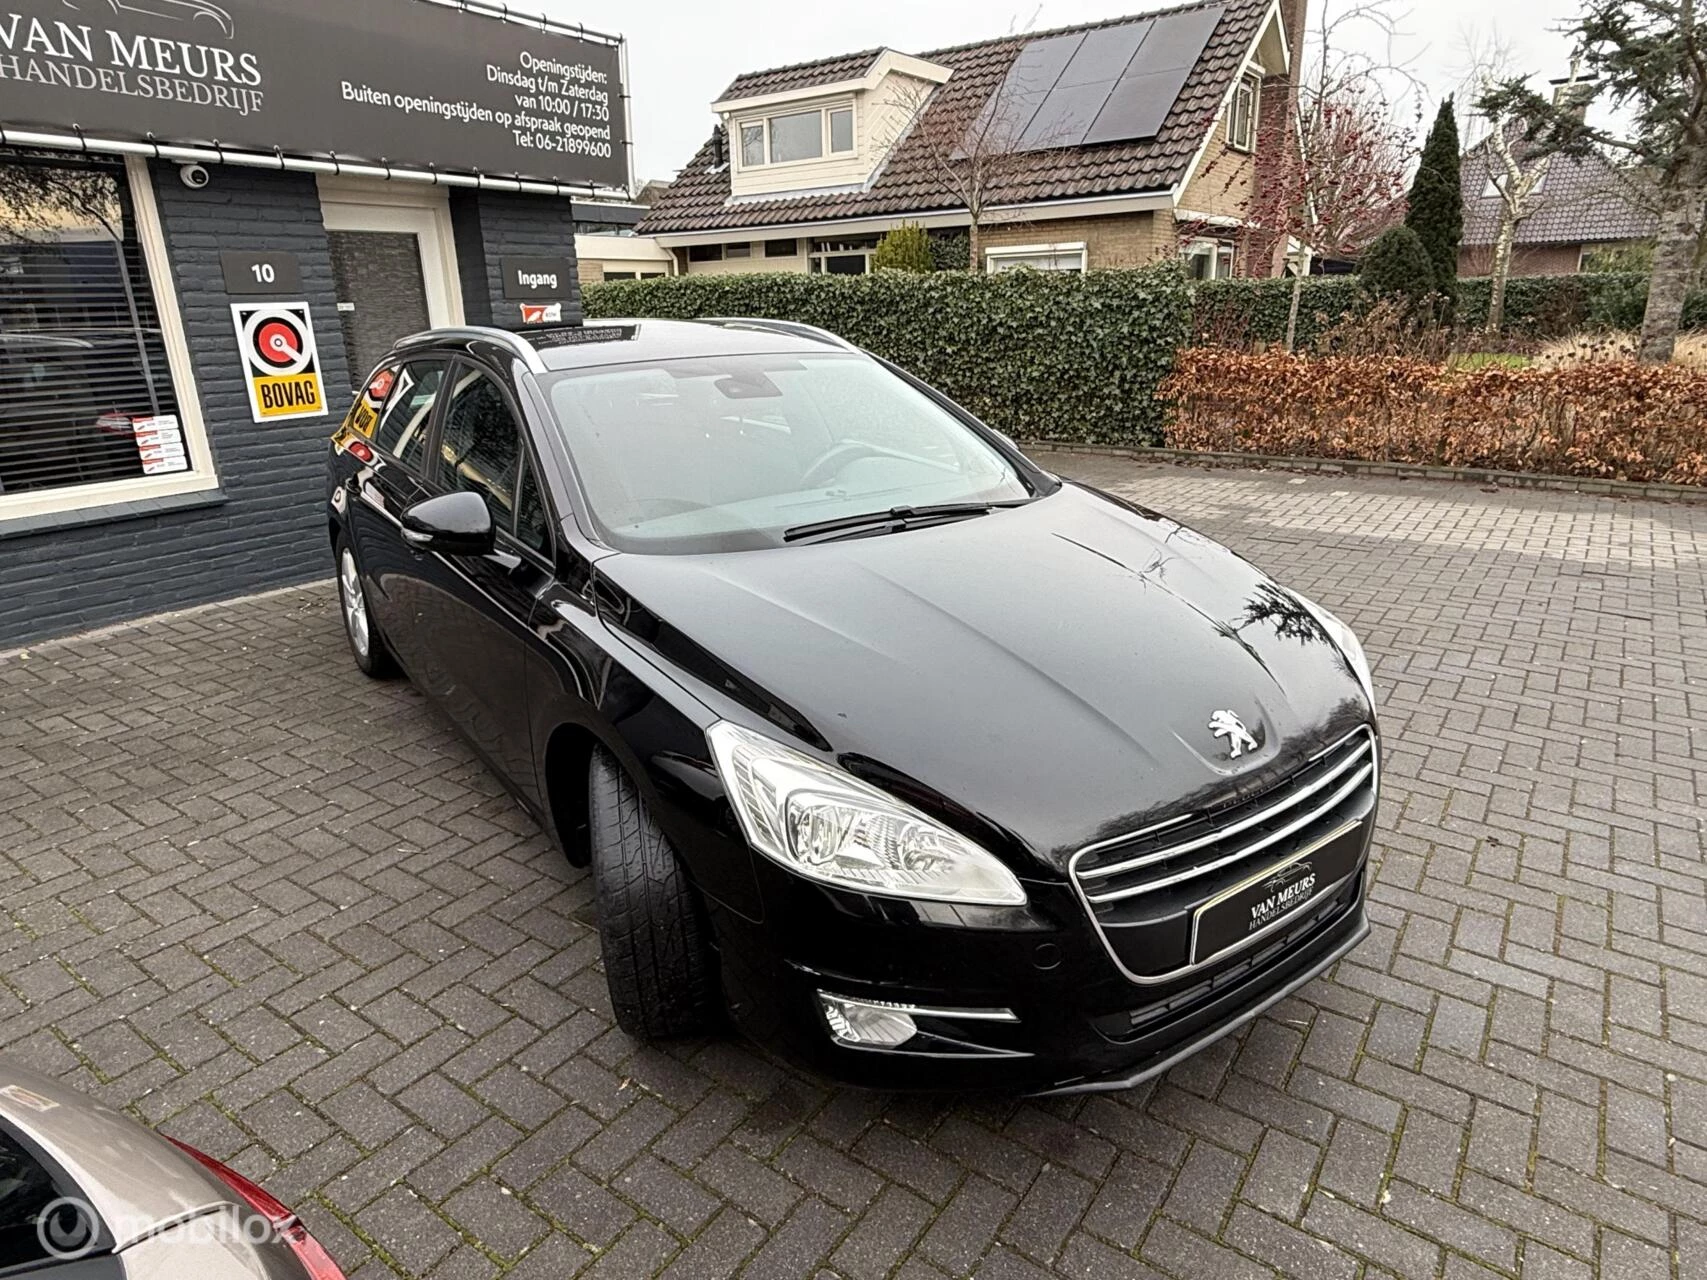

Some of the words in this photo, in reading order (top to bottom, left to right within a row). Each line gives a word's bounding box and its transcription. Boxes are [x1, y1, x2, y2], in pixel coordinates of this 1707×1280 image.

[0, 13, 93, 62] VAN
[105, 29, 263, 86] MEURS
[519, 51, 608, 84] Openingstijden:
[0, 53, 264, 116] HANDELSBEDRIJF
[486, 64, 536, 94] Dinsdag
[538, 75, 558, 94] t/m
[560, 79, 608, 107] Zaterdag
[341, 81, 391, 107] Buiten
[394, 93, 493, 123] openingstijden
[495, 110, 513, 128] op
[514, 112, 562, 134] afspraak
[563, 121, 611, 142] geopend
[514, 94, 537, 108] van
[538, 95, 570, 116] 10:00
[573, 100, 579, 118] /
[580, 102, 610, 122] 17:30
[513, 129, 534, 149] Tel:
[535, 132, 612, 158] 06-21899600
[251, 263, 275, 283] 10
[517, 269, 558, 290] Ingang
[260, 380, 316, 409] BOVAG
[1251, 895, 1276, 919] VAN
[1276, 872, 1316, 906] MEURS
